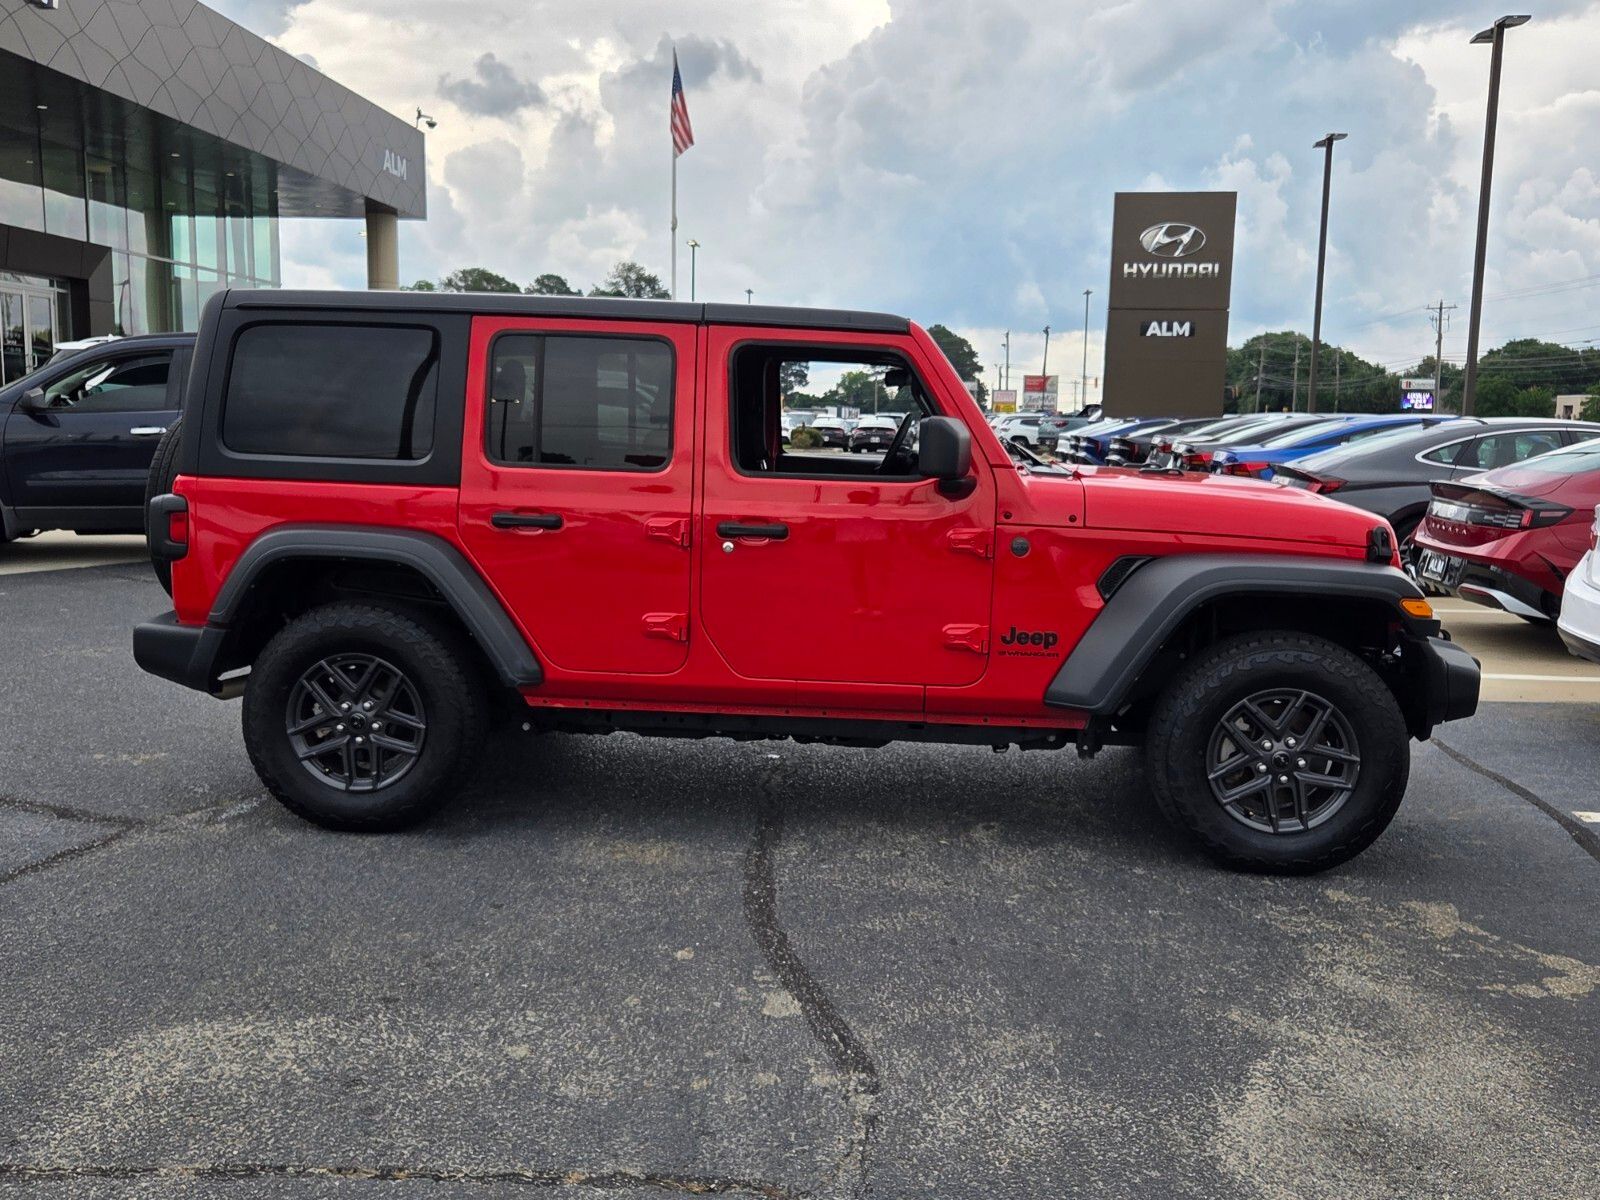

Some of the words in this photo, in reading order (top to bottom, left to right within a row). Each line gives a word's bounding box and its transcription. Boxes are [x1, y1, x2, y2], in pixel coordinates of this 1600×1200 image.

[383, 149, 407, 181] ALM
[1123, 262, 1220, 279] HYUNDAI
[1145, 320, 1191, 337] ALM
[1000, 626, 1058, 650] Jeep
